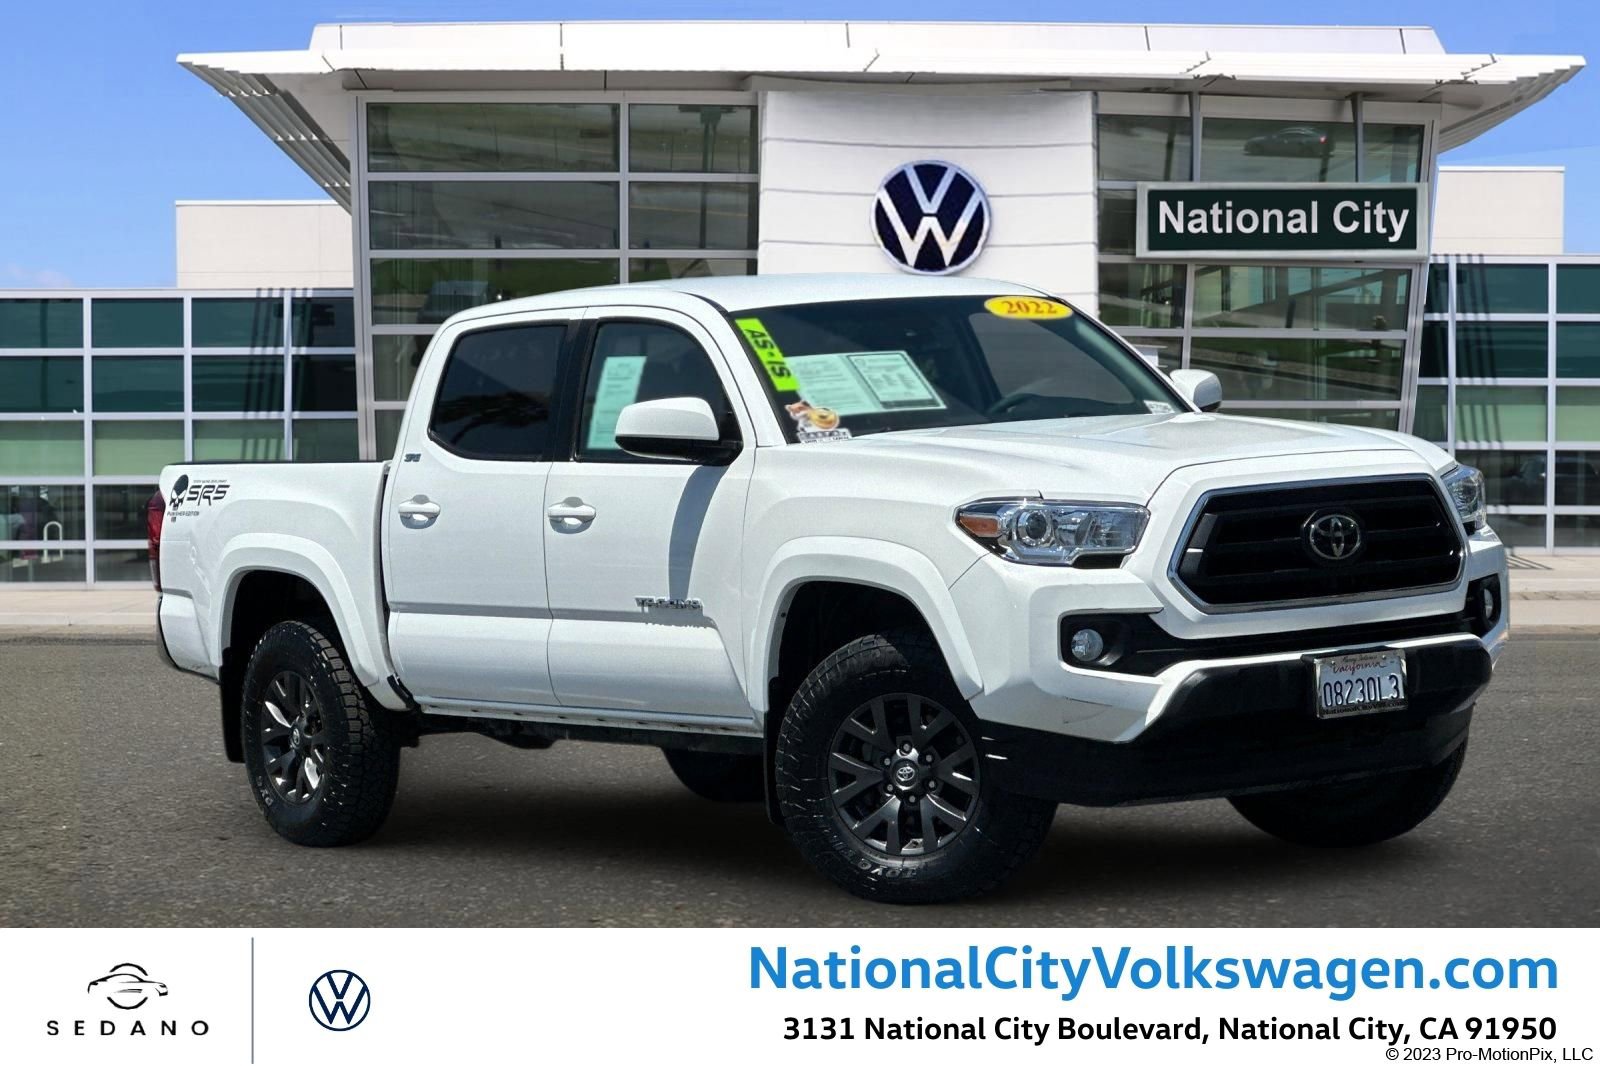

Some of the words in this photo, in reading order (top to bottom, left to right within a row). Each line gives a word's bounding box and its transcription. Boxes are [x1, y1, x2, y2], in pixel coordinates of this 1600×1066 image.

[1158, 200, 1318, 234] National
[1332, 200, 1410, 242] City
[1001, 301, 1057, 314] 2022
